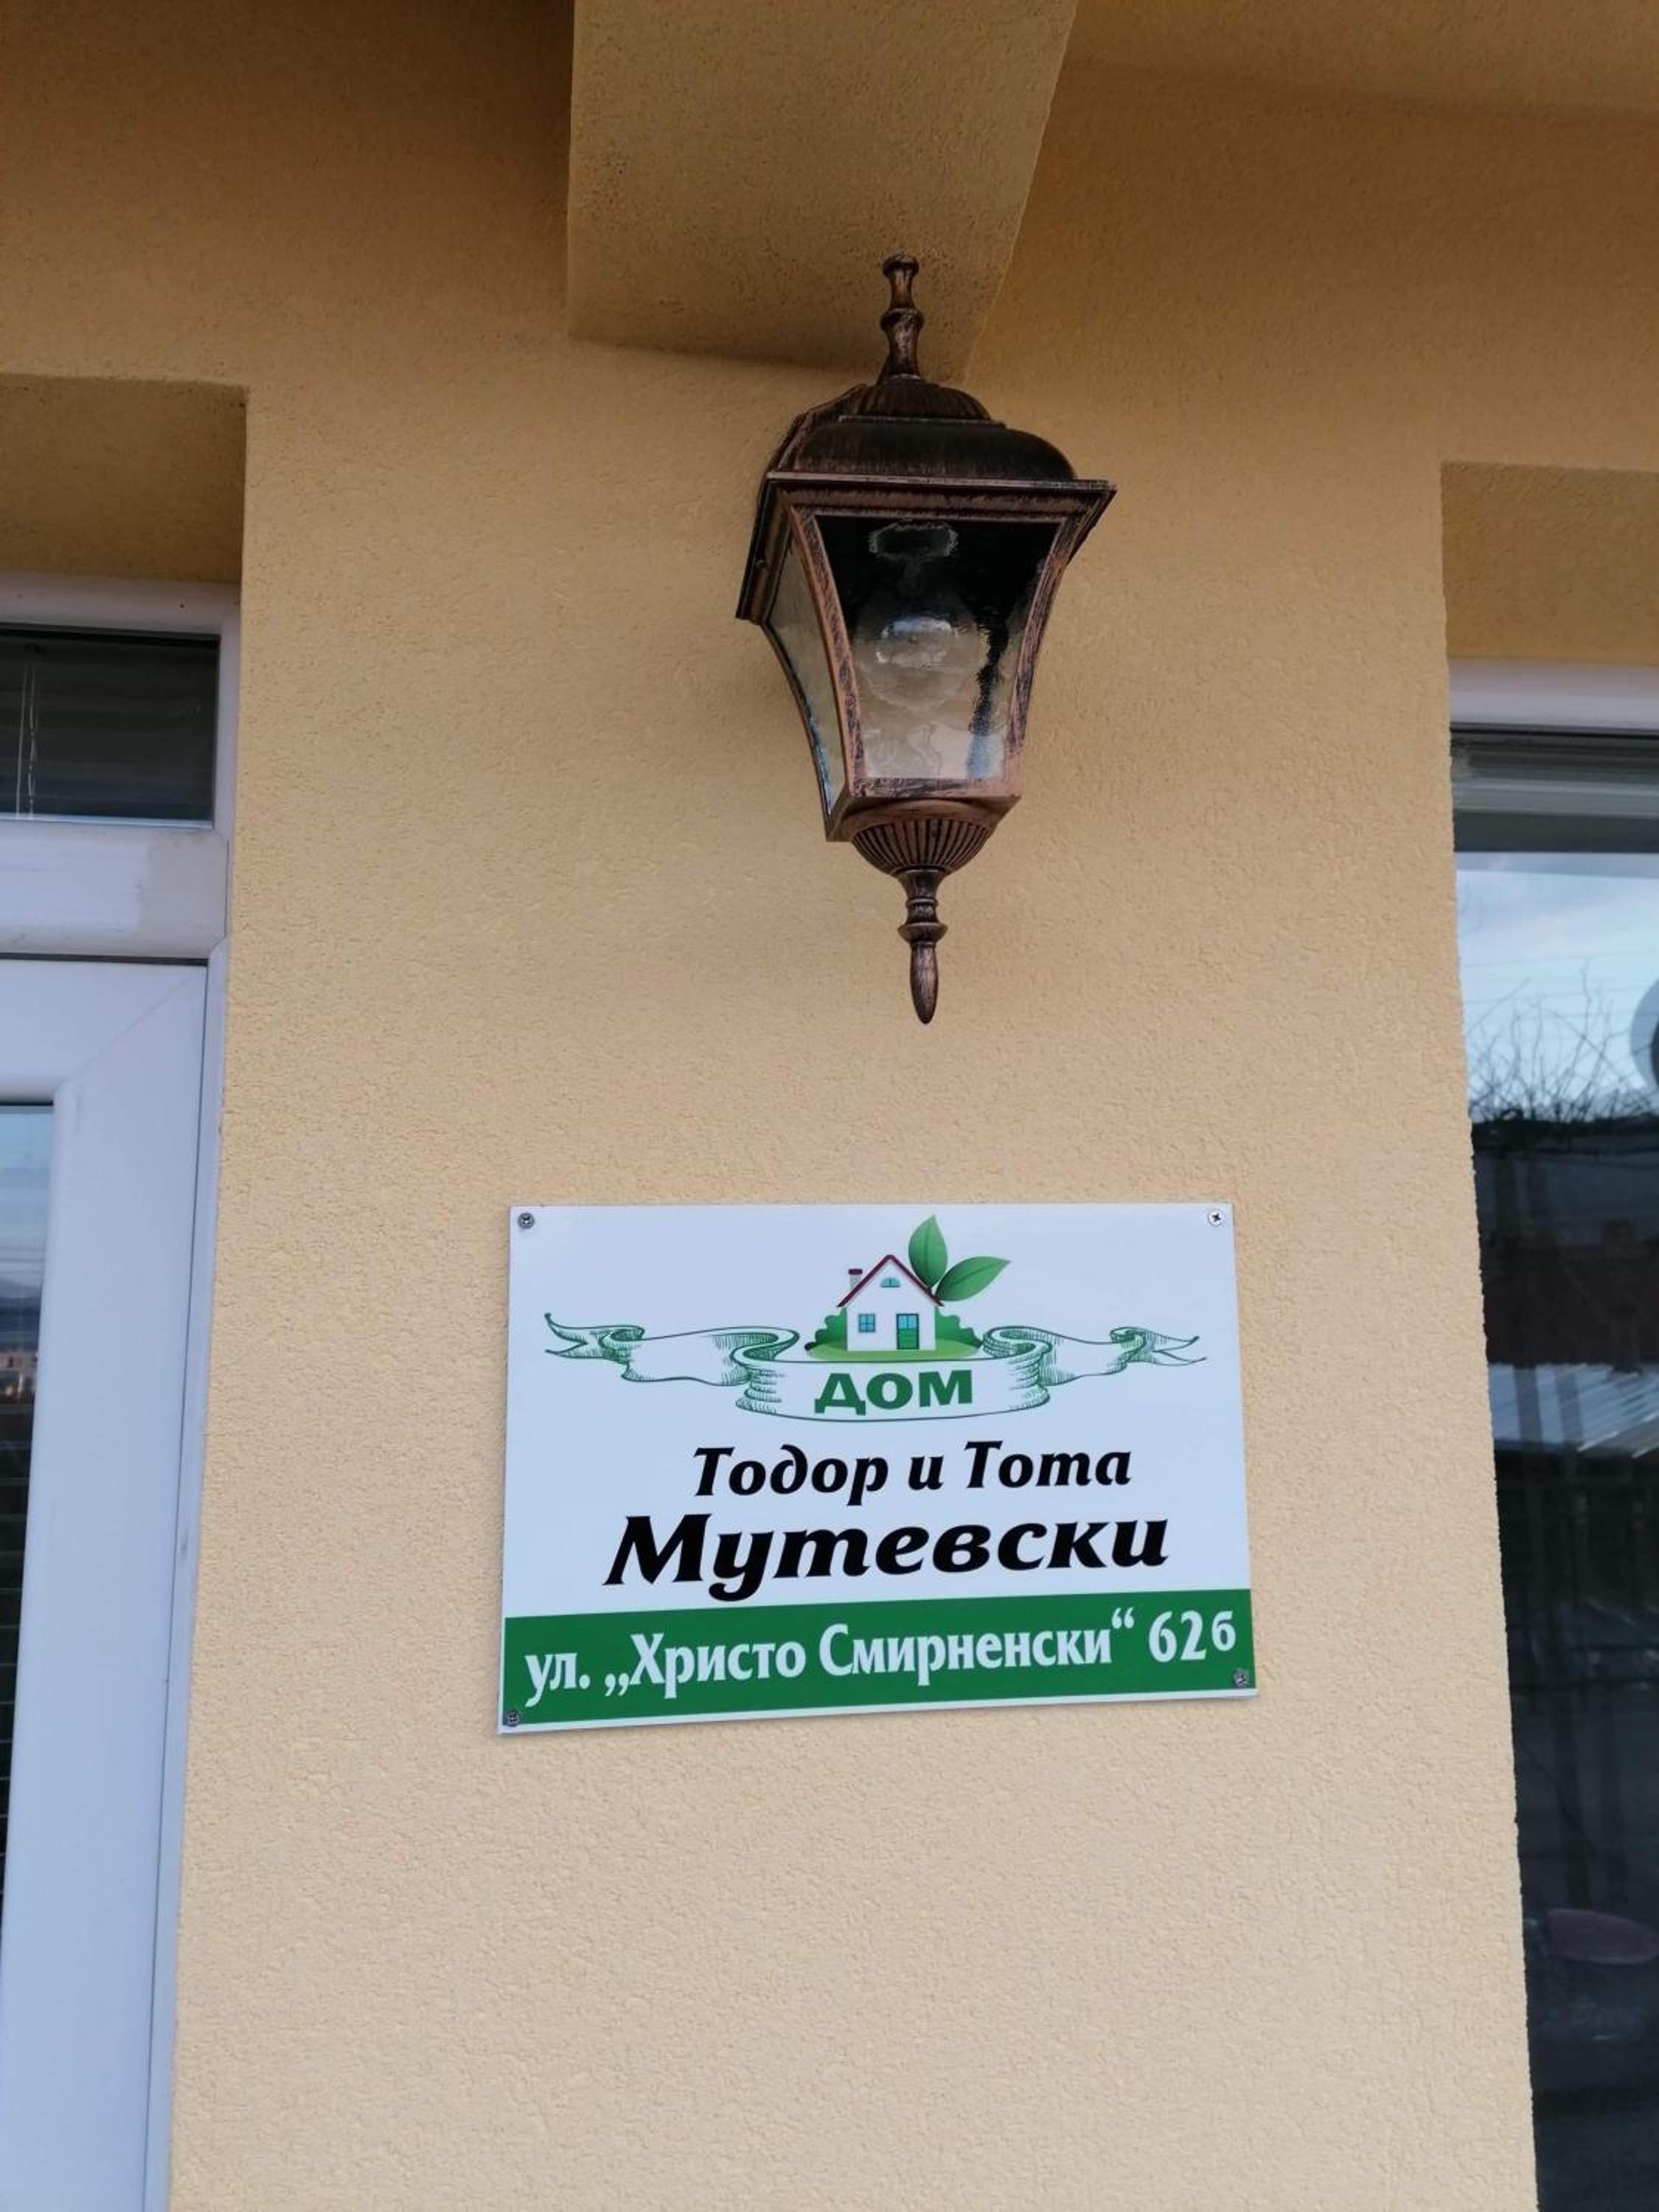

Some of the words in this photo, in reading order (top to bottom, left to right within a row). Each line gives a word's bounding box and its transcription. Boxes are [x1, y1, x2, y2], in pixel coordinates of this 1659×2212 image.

[814, 1369, 973, 1416] ДОМ
[693, 1444, 888, 1506] Тодор
[908, 1455, 945, 1491] и
[964, 1440, 1131, 1489] Тота
[602, 1513, 1169, 1602] Мутевски
[525, 1652, 591, 1707] ул.
[605, 1633, 806, 1700] „Христо
